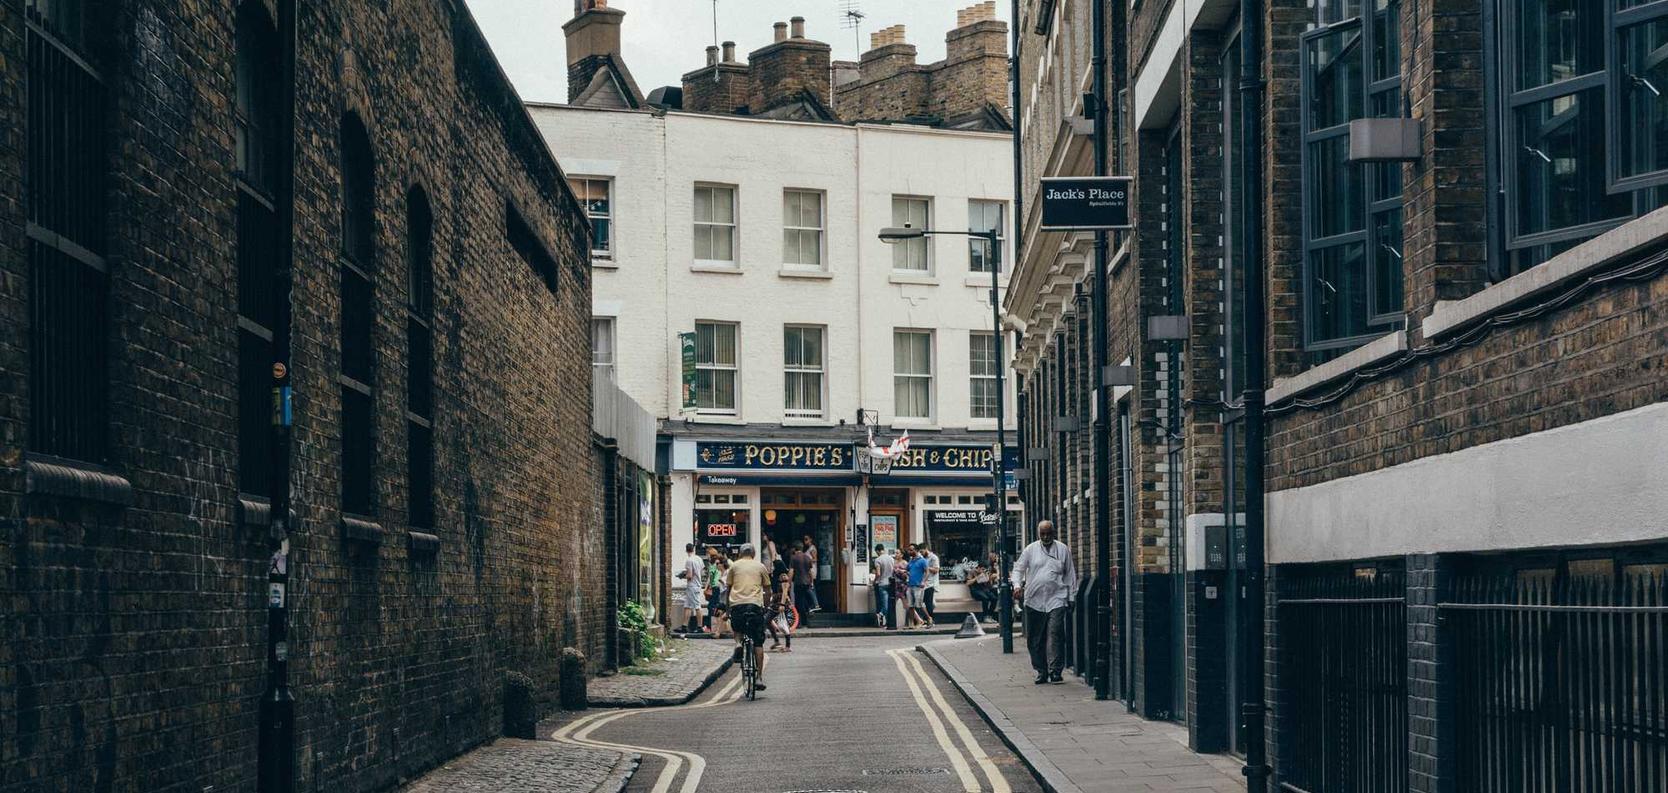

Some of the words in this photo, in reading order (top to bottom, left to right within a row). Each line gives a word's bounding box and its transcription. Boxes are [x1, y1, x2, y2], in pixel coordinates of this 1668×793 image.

[1046, 189, 1085, 200] Jack's
[1088, 189, 1124, 199] Place
[744, 444, 843, 466] POPPIE'S
[929, 450, 941, 465] &
[943, 448, 994, 468] CHIP
[707, 475, 737, 485] Takeaway
[710, 524, 735, 536] OPEN
